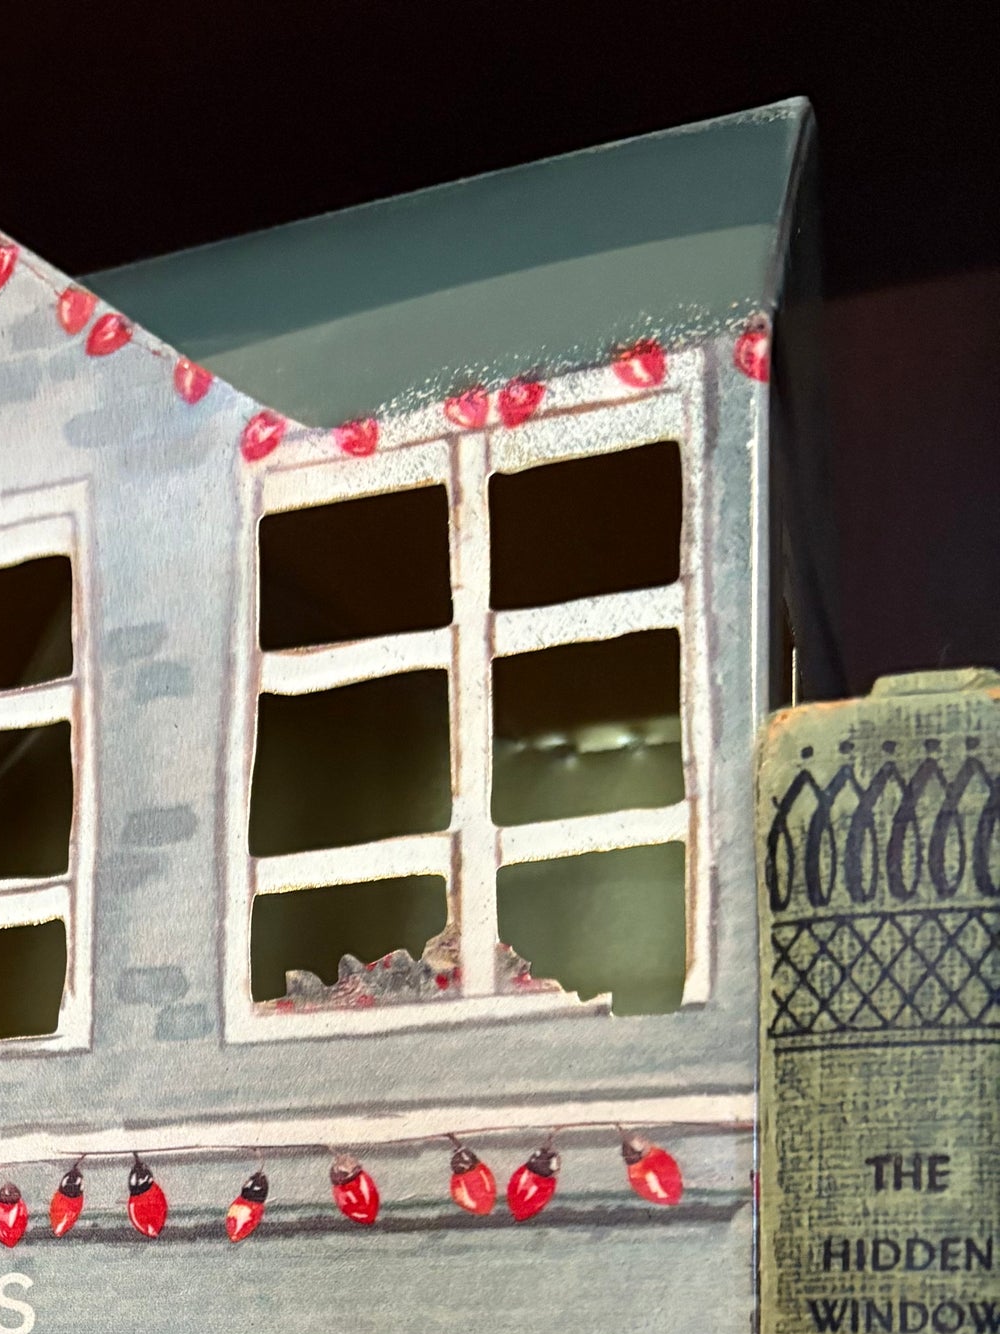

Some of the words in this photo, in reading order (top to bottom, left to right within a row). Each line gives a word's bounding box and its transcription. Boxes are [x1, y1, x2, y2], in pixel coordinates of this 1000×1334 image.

[864, 1154, 951, 1192] THE
[822, 1234, 993, 1272] HIDDEN
[807, 1300, 1000, 1334] WINDOW
